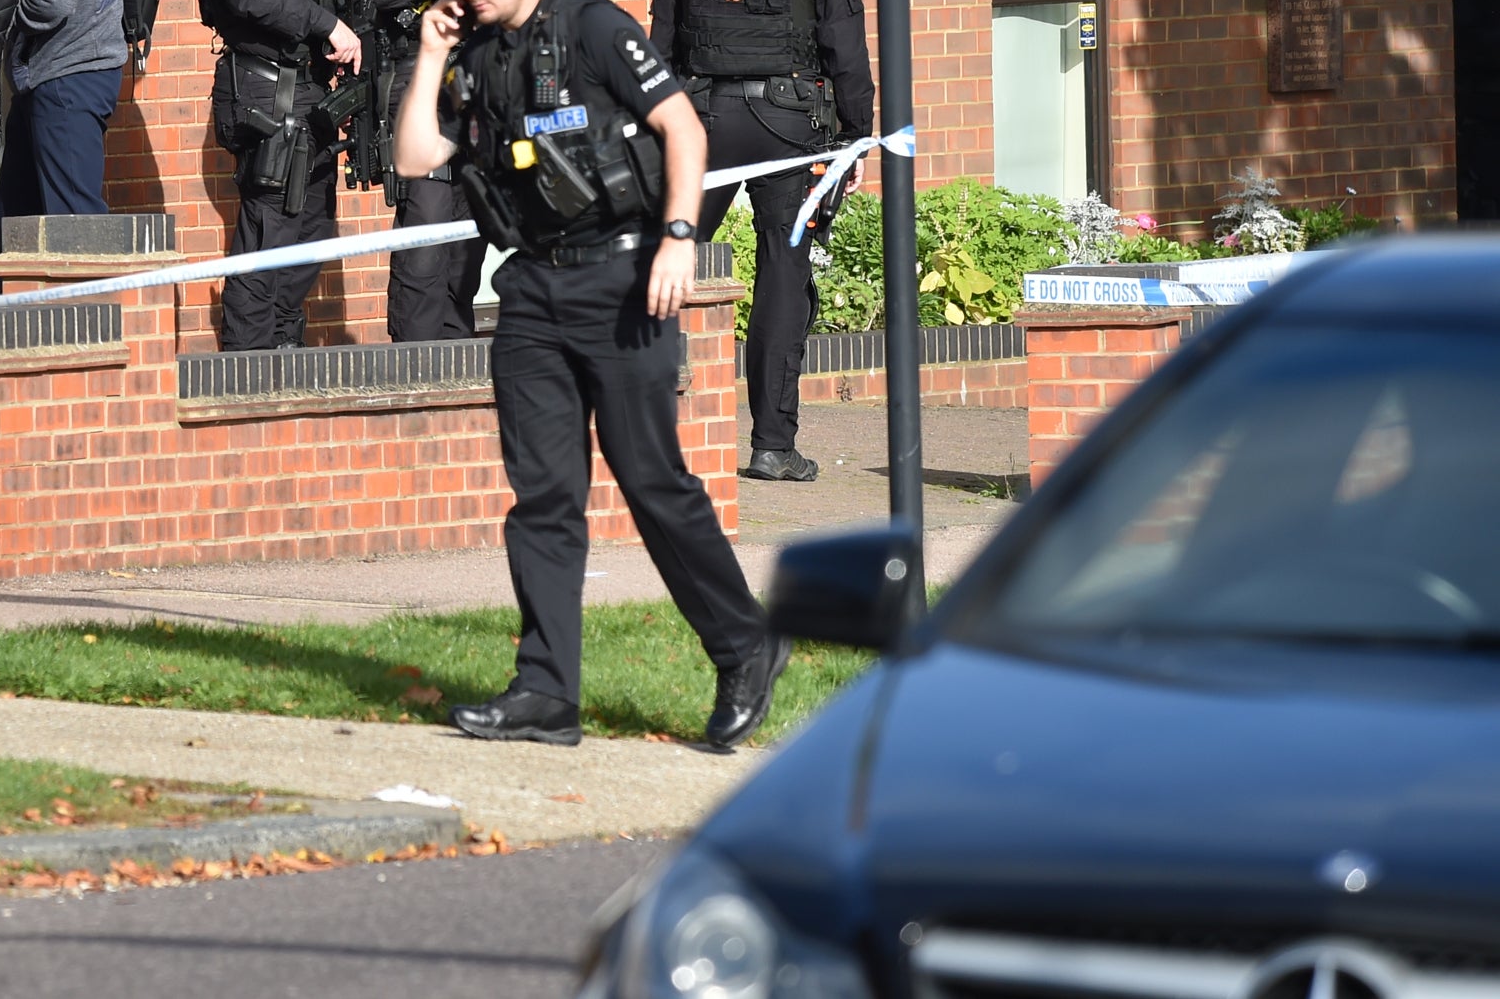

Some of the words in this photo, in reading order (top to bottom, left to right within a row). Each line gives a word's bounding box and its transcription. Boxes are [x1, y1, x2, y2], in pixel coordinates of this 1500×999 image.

[641, 69, 670, 93] POLICE
[529, 110, 583, 136] POLICE
[1040, 280, 1058, 300] DO
[1063, 280, 1090, 301] NOT
[1093, 281, 1138, 302] CROSS
